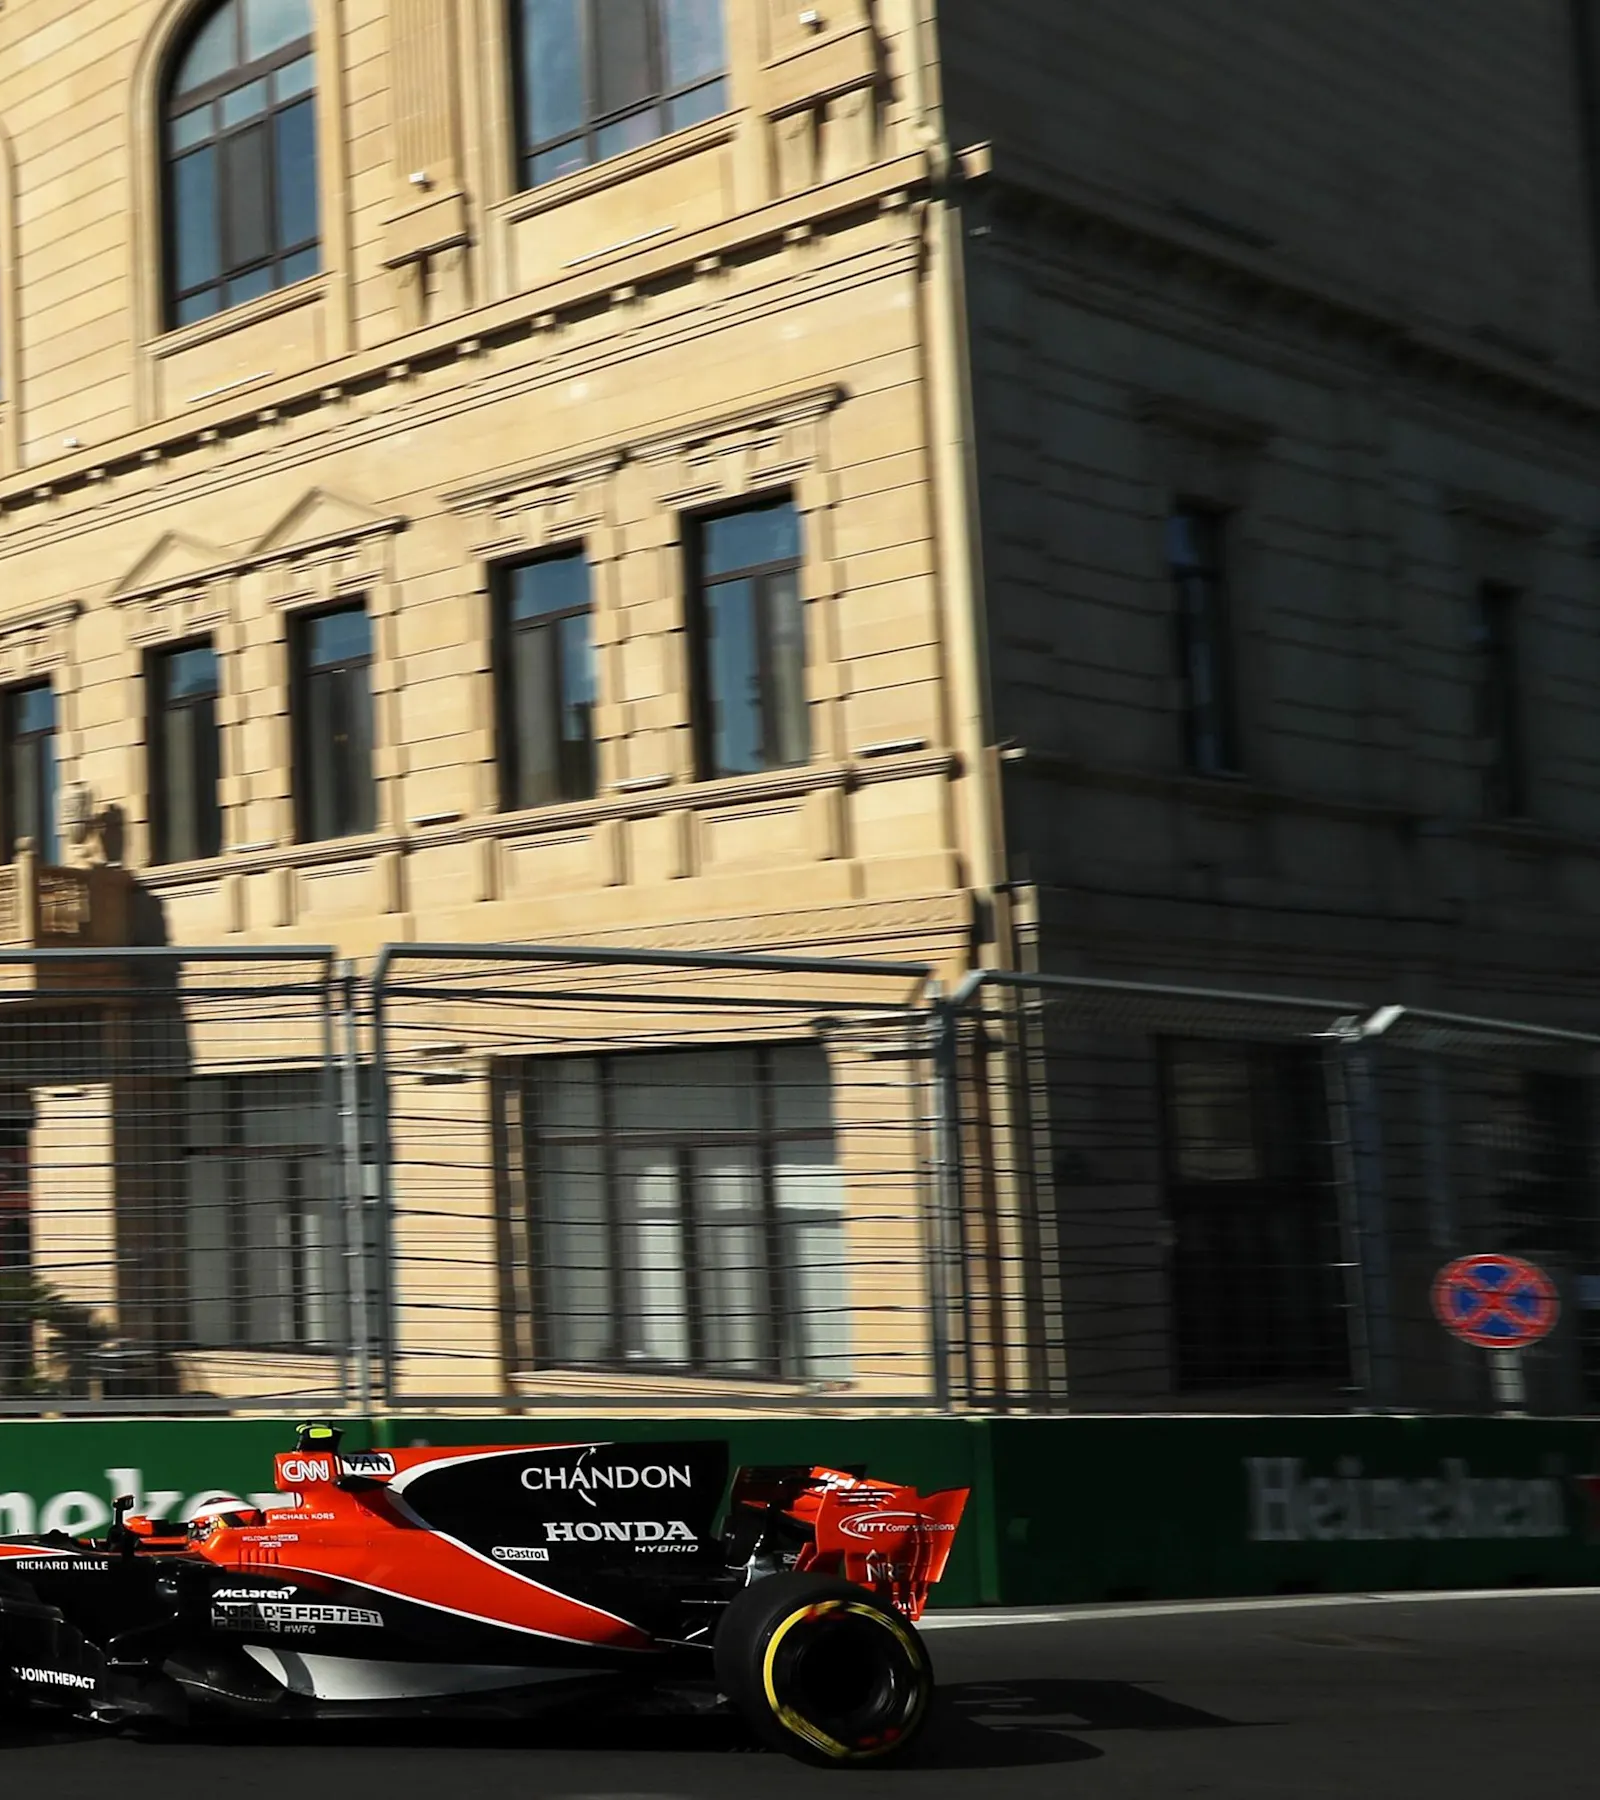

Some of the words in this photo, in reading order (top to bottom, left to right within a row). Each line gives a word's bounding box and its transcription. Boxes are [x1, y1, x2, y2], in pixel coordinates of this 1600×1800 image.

[281, 1459, 331, 1482] CNN
[521, 1465, 691, 1490] CHANDON
[271, 1513, 309, 1521] MICHAEL
[311, 1512, 336, 1520] KORS
[542, 1520, 698, 1542] HONDA
[856, 1522, 886, 1533] NTT
[886, 1522, 956, 1532] Comcations
[506, 1548, 547, 1559] Castrol
[634, 1544, 699, 1553] HYBRID
[16, 1561, 69, 1570] RICHARD
[72, 1561, 109, 1570] MILLE
[212, 1587, 290, 1600] McLaren
[295, 1607, 383, 1623] FASTEST
[284, 1624, 317, 1634] #WFG
